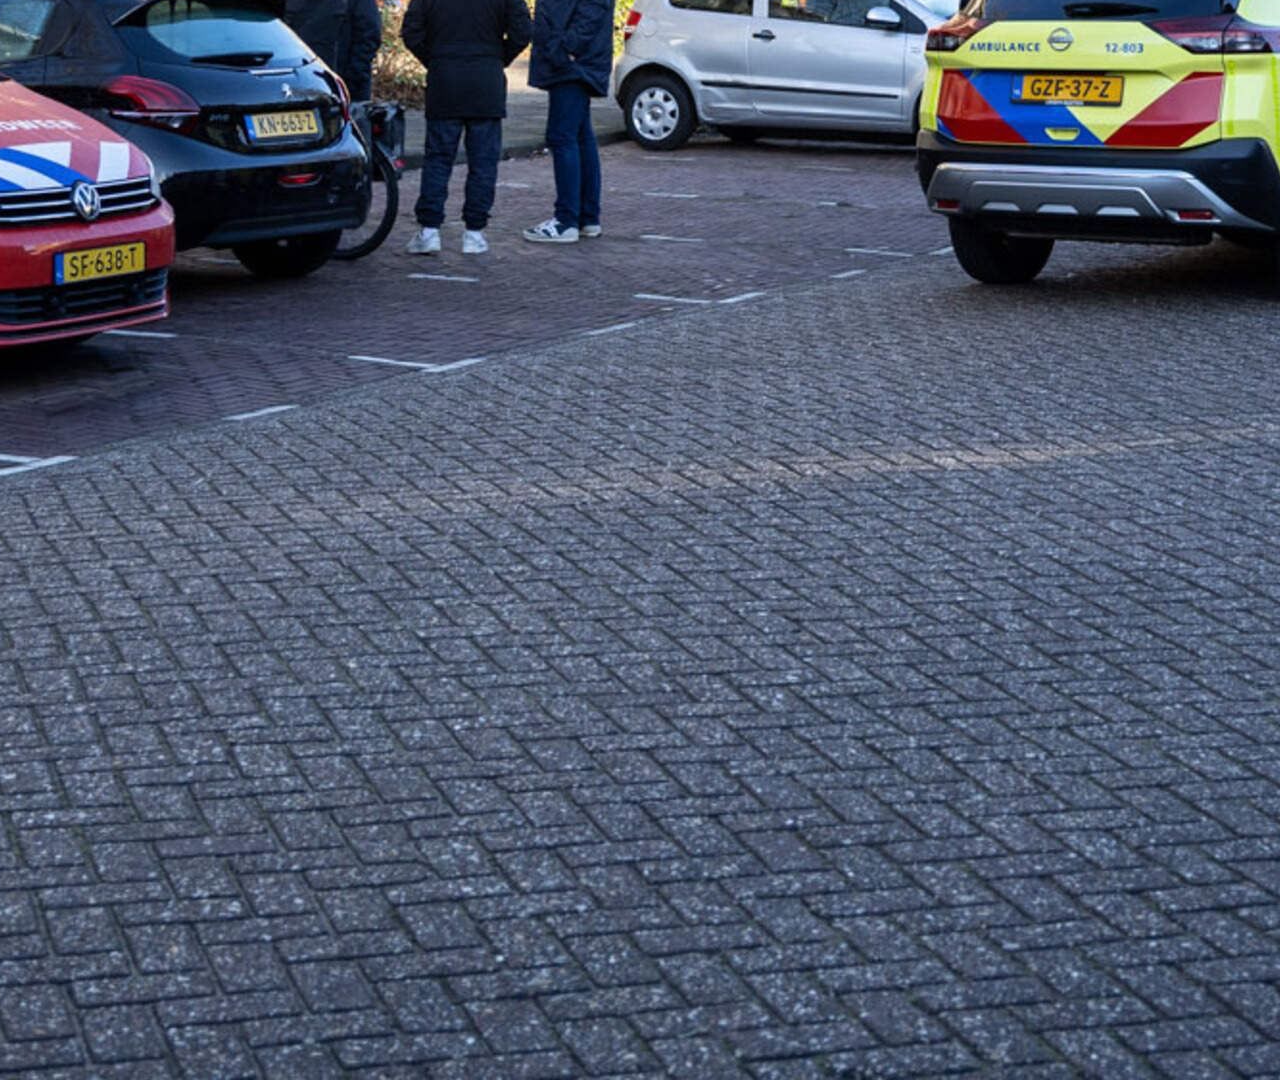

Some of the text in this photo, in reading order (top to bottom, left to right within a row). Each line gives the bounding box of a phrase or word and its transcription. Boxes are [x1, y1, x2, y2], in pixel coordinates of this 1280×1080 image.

[969, 41, 1040, 53] AMBULANCE
[1104, 42, 1144, 54] 12-803
[1030, 78, 1112, 98] GZF-37-Z
[258, 113, 314, 134] KN-663-Z
[69, 247, 137, 277] SF-638-T
